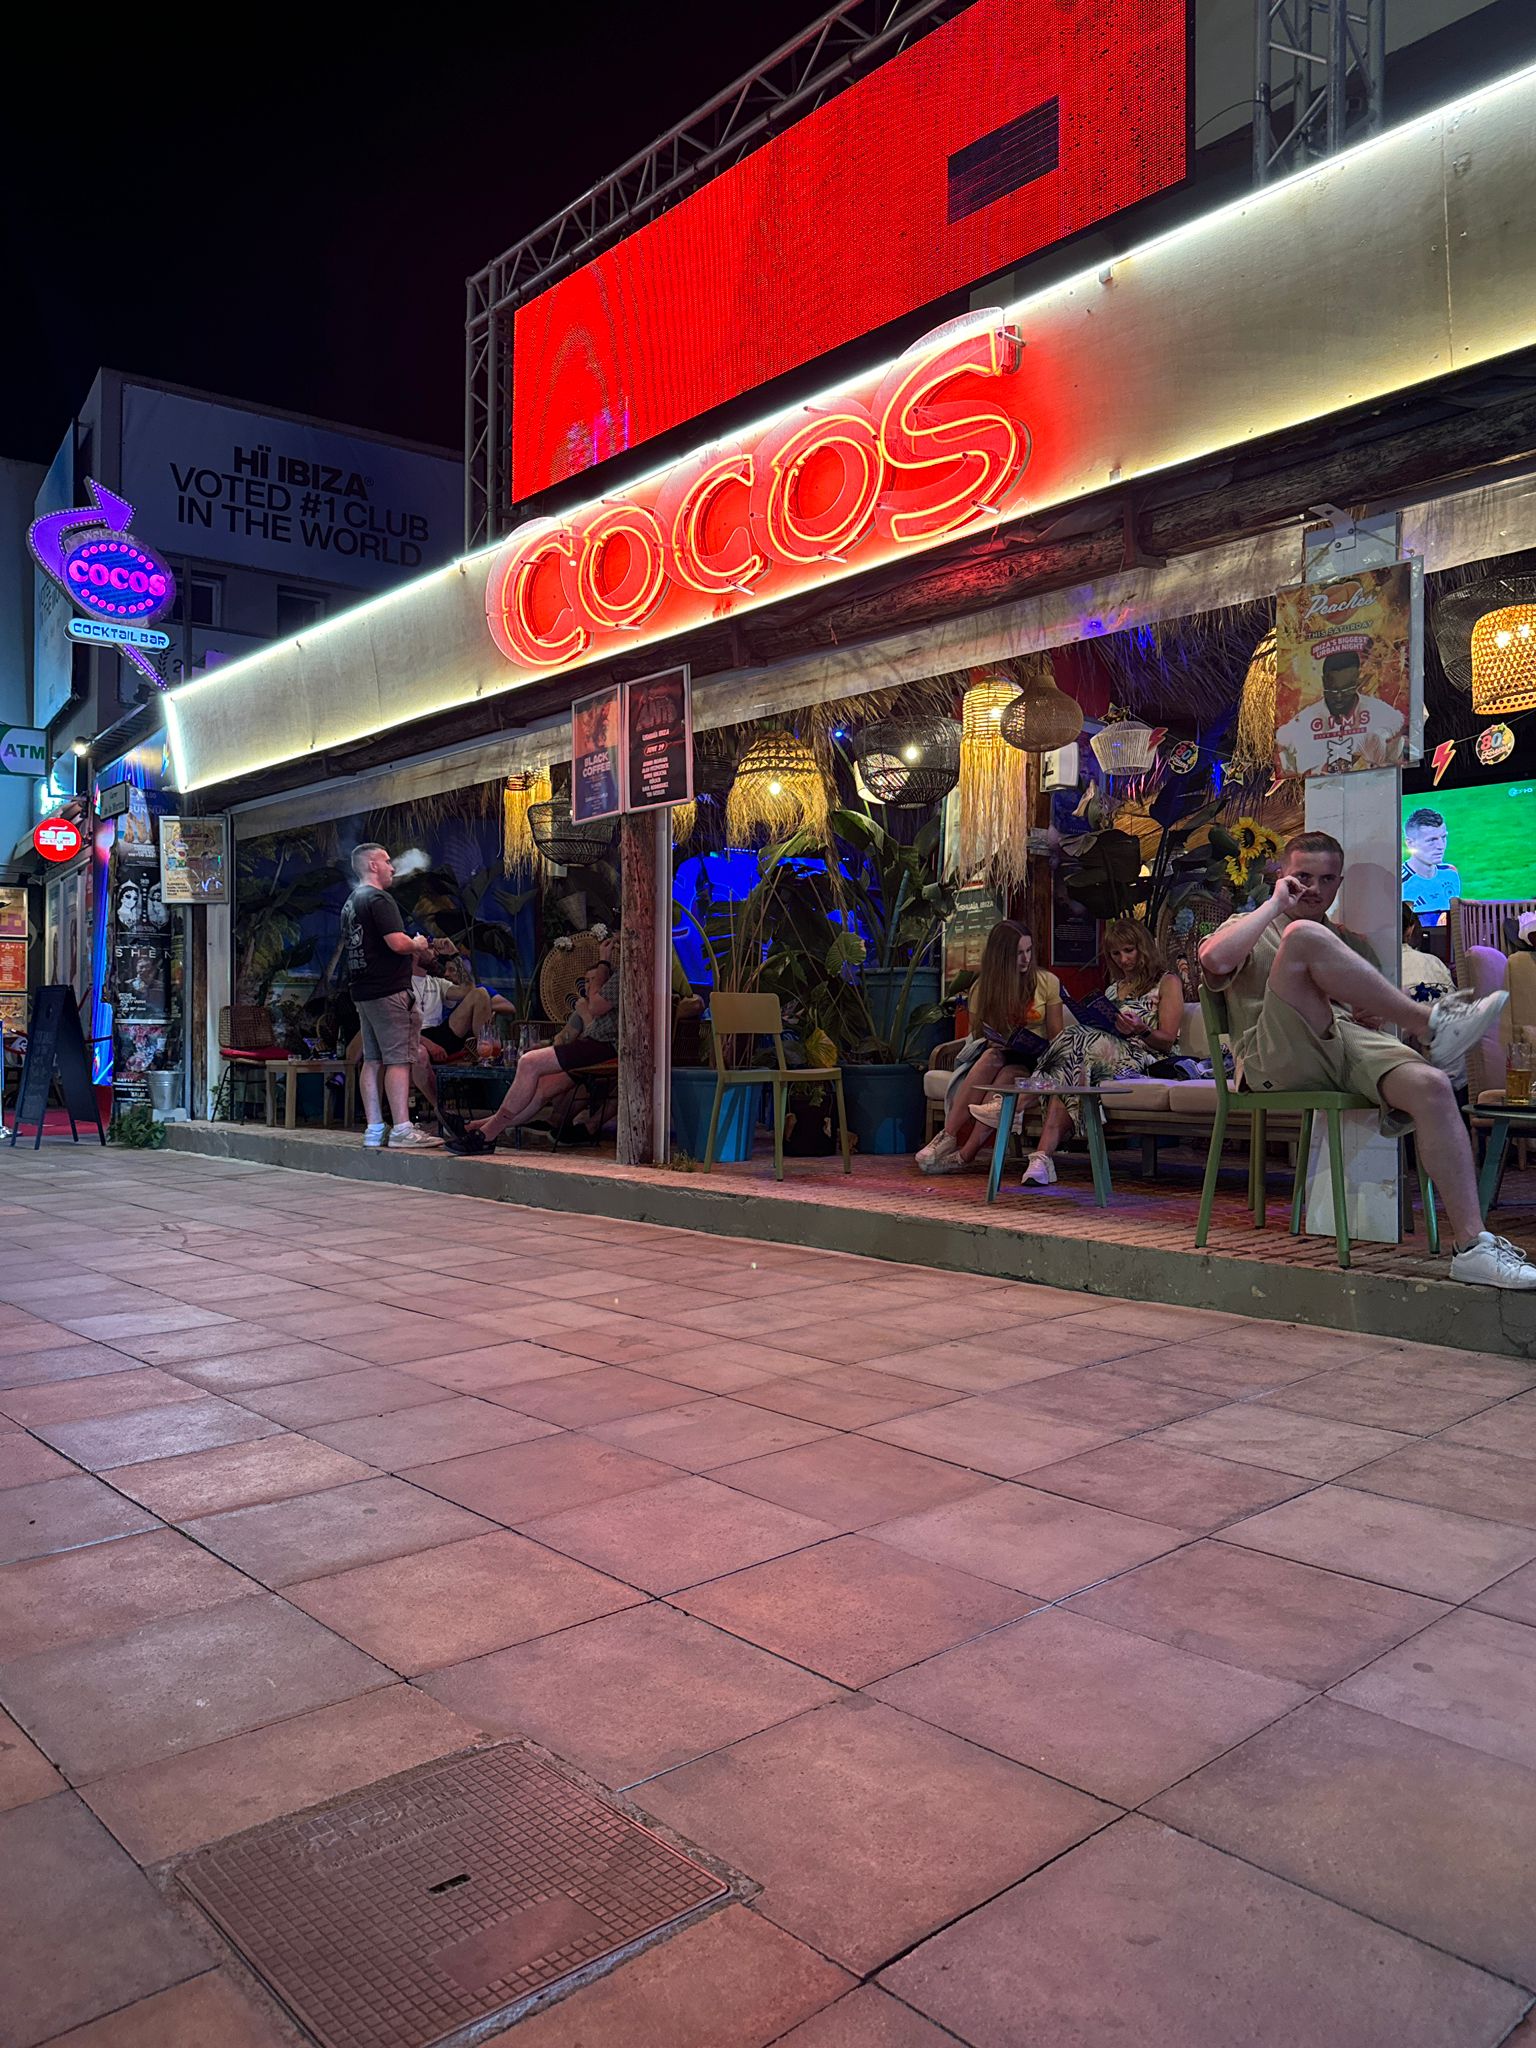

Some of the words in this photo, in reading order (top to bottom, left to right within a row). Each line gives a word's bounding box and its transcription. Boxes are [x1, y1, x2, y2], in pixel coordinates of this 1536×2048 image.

[234, 445, 271, 479] HÏ
[486, 307, 1028, 667] COCOS
[170, 463, 291, 511] VOTED
[300, 492, 335, 522] #1
[344, 501, 429, 542] CLUB
[178, 496, 212, 528] IN
[222, 504, 291, 543] THE
[300, 520, 422, 567] WORLD
[69, 560, 166, 597] COCOS
[1304, 588, 1377, 619] Peaches
[1307, 631, 1329, 640] THIS
[1329, 621, 1374, 636] SATURDAY
[1312, 639, 1337, 653] IBIZA'S
[1338, 637, 1368, 645] BIGGEST
[1316, 646, 1340, 657] URBAN
[1341, 643, 1364, 651] NIGHT
[1311, 710, 1370, 731] GIMS
[3, 744, 45, 759] ATM
[584, 751, 608, 767] BLACK
[582, 761, 611, 777] COFFEE
